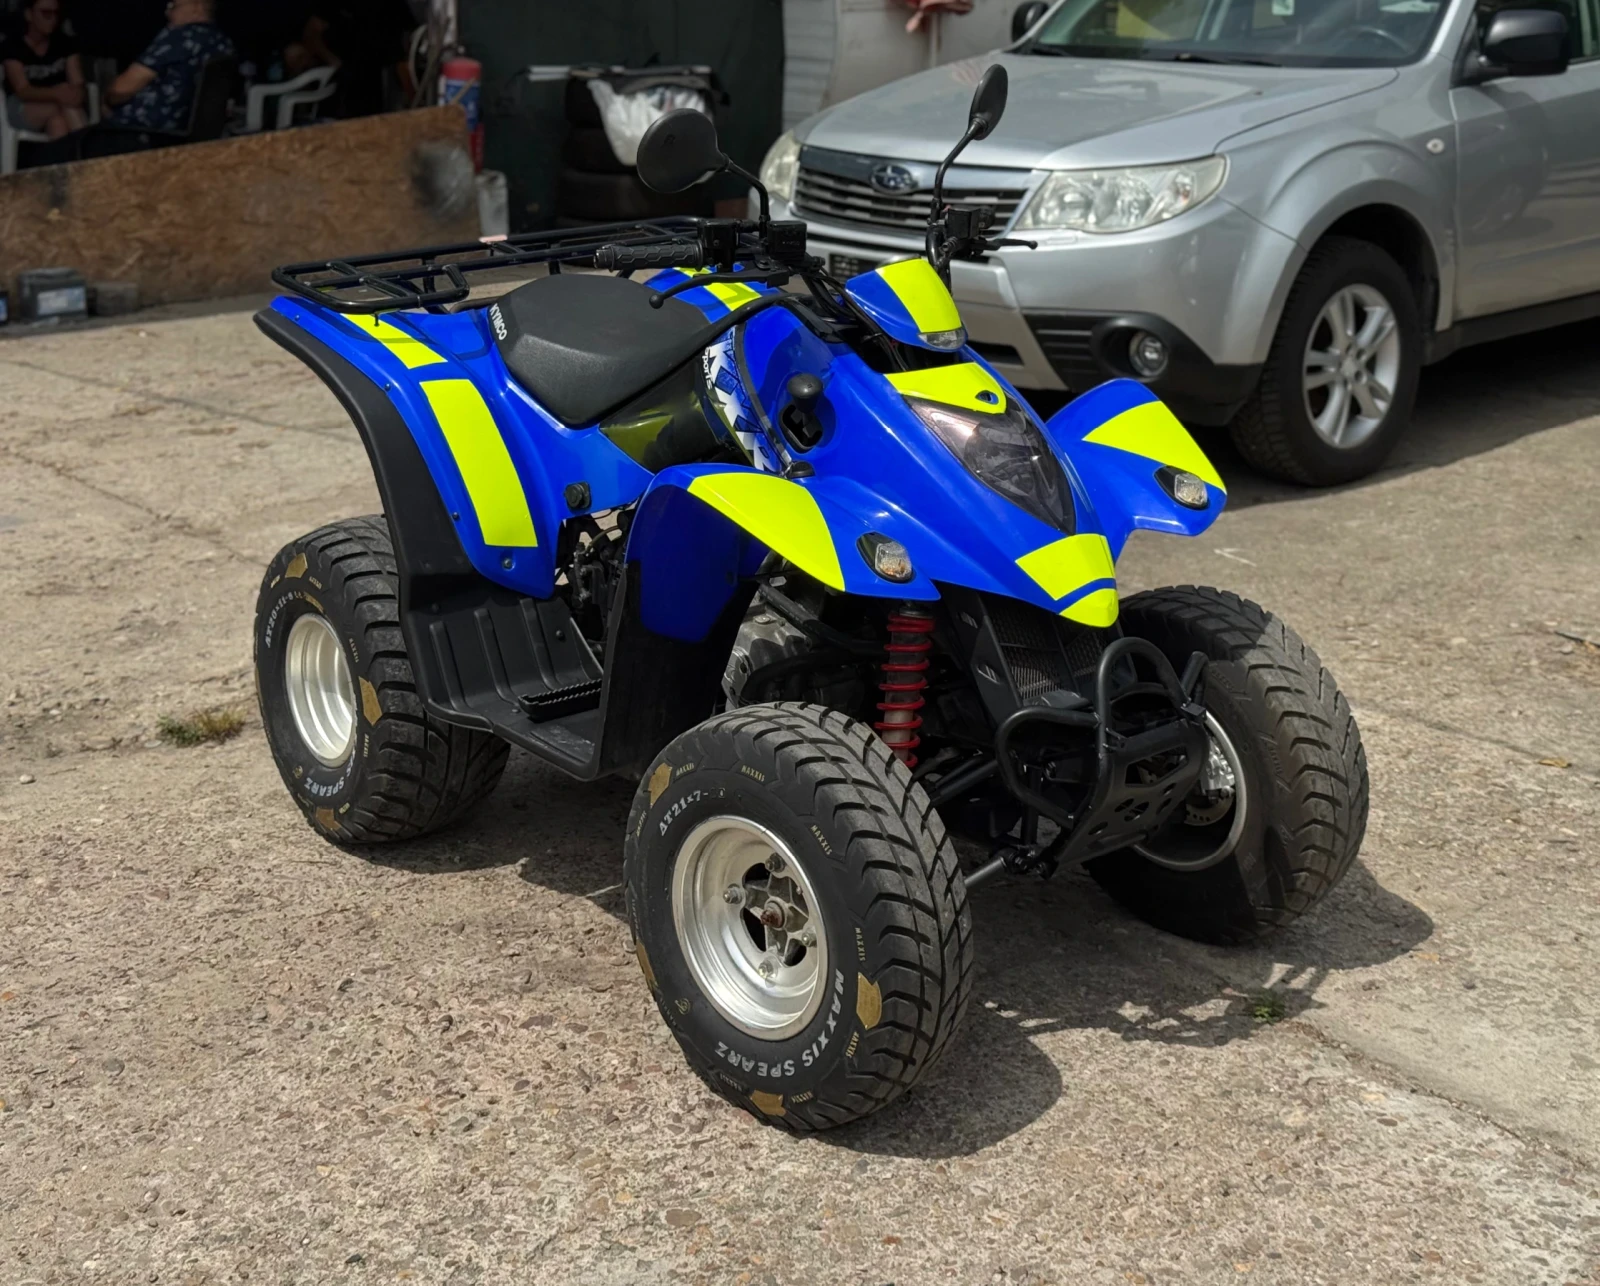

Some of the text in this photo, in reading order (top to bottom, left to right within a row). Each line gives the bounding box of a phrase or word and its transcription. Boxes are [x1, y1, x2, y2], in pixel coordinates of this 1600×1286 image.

[489, 302, 508, 341] KYMCO
[809, 824, 834, 857] MAXXIS
[854, 926, 867, 963] MAXXIS
[714, 968, 845, 1078] MAXXIS SPEARZ
